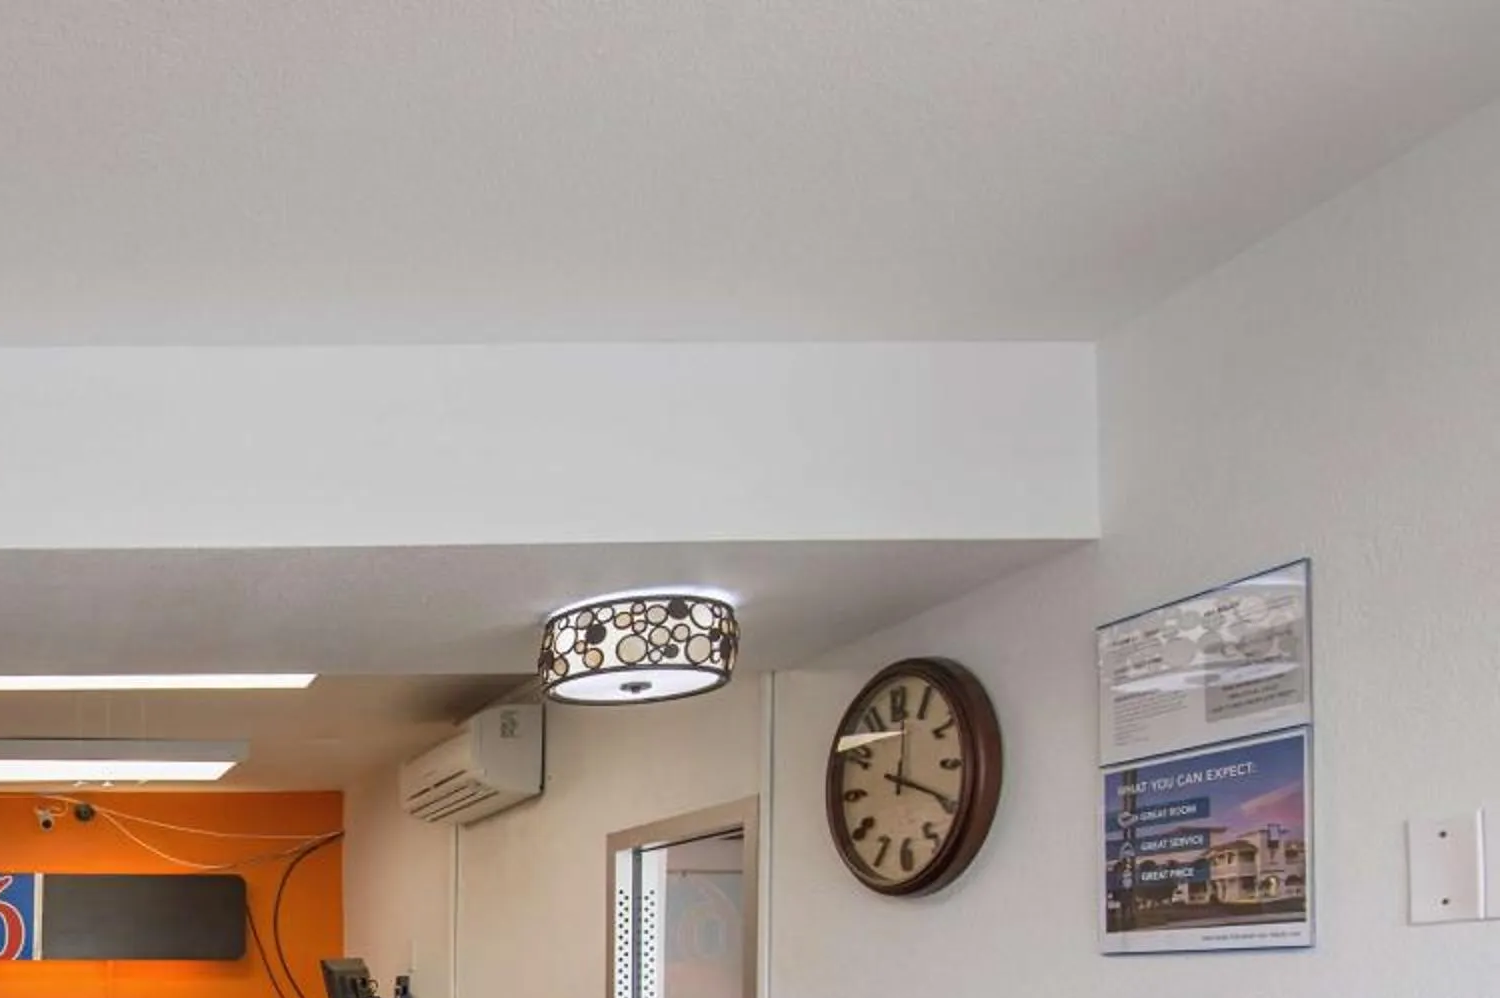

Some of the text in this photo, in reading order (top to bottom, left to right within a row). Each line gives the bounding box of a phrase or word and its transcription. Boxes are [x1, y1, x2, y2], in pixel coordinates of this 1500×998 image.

[1117, 782, 1148, 796] WHAT
[1151, 777, 1175, 792] YOU
[1177, 771, 1203, 787] CAN
[1139, 803, 1197, 821] GREAT ROOM
[1140, 838, 1168, 851] GREAT
[1141, 869, 1169, 882] GREAT
